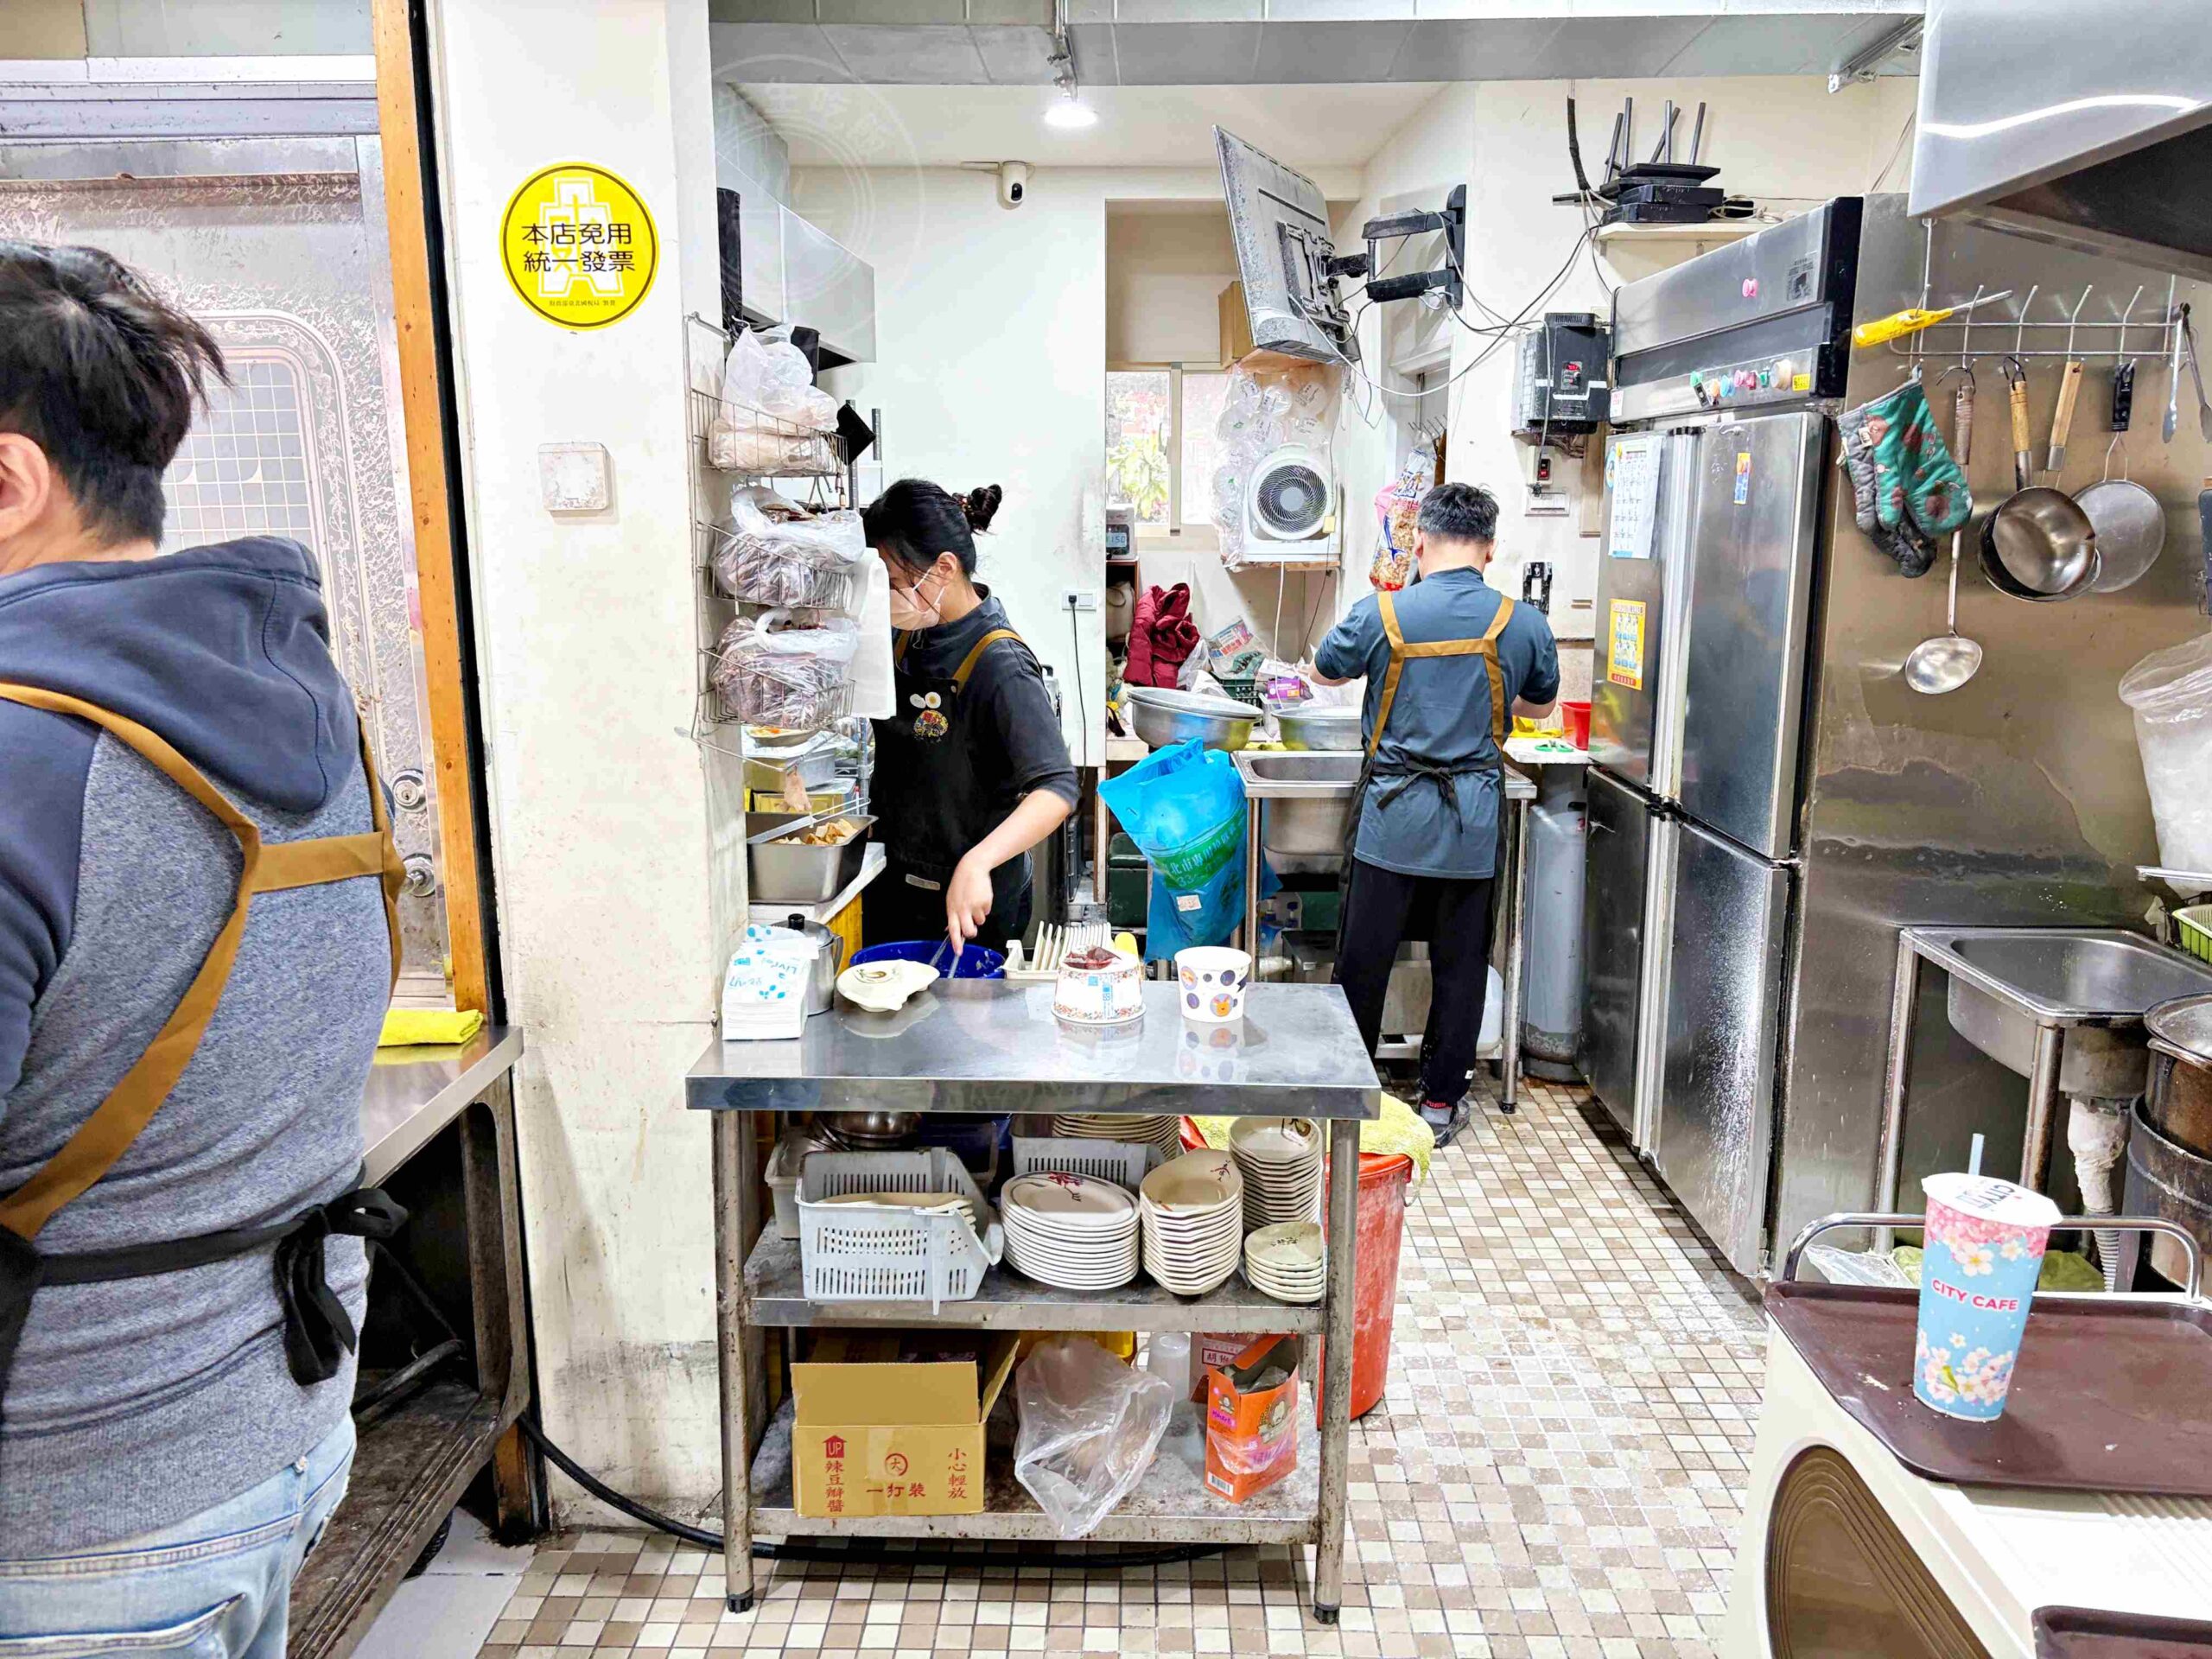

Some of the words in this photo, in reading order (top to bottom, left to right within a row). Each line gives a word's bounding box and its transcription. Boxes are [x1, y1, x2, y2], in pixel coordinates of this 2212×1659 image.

[521, 222, 632, 245] 本店免用
[523, 250, 636, 273] 統一發票
[1932, 1279, 1968, 1303] CITY
[1973, 1294, 2019, 1312] CAFE
[828, 1441, 843, 1456] UP
[947, 1447, 968, 1499] 小心輕放
[824, 1460, 845, 1513] 辣豆瓣醬
[865, 1482, 927, 1498] 一打裝
